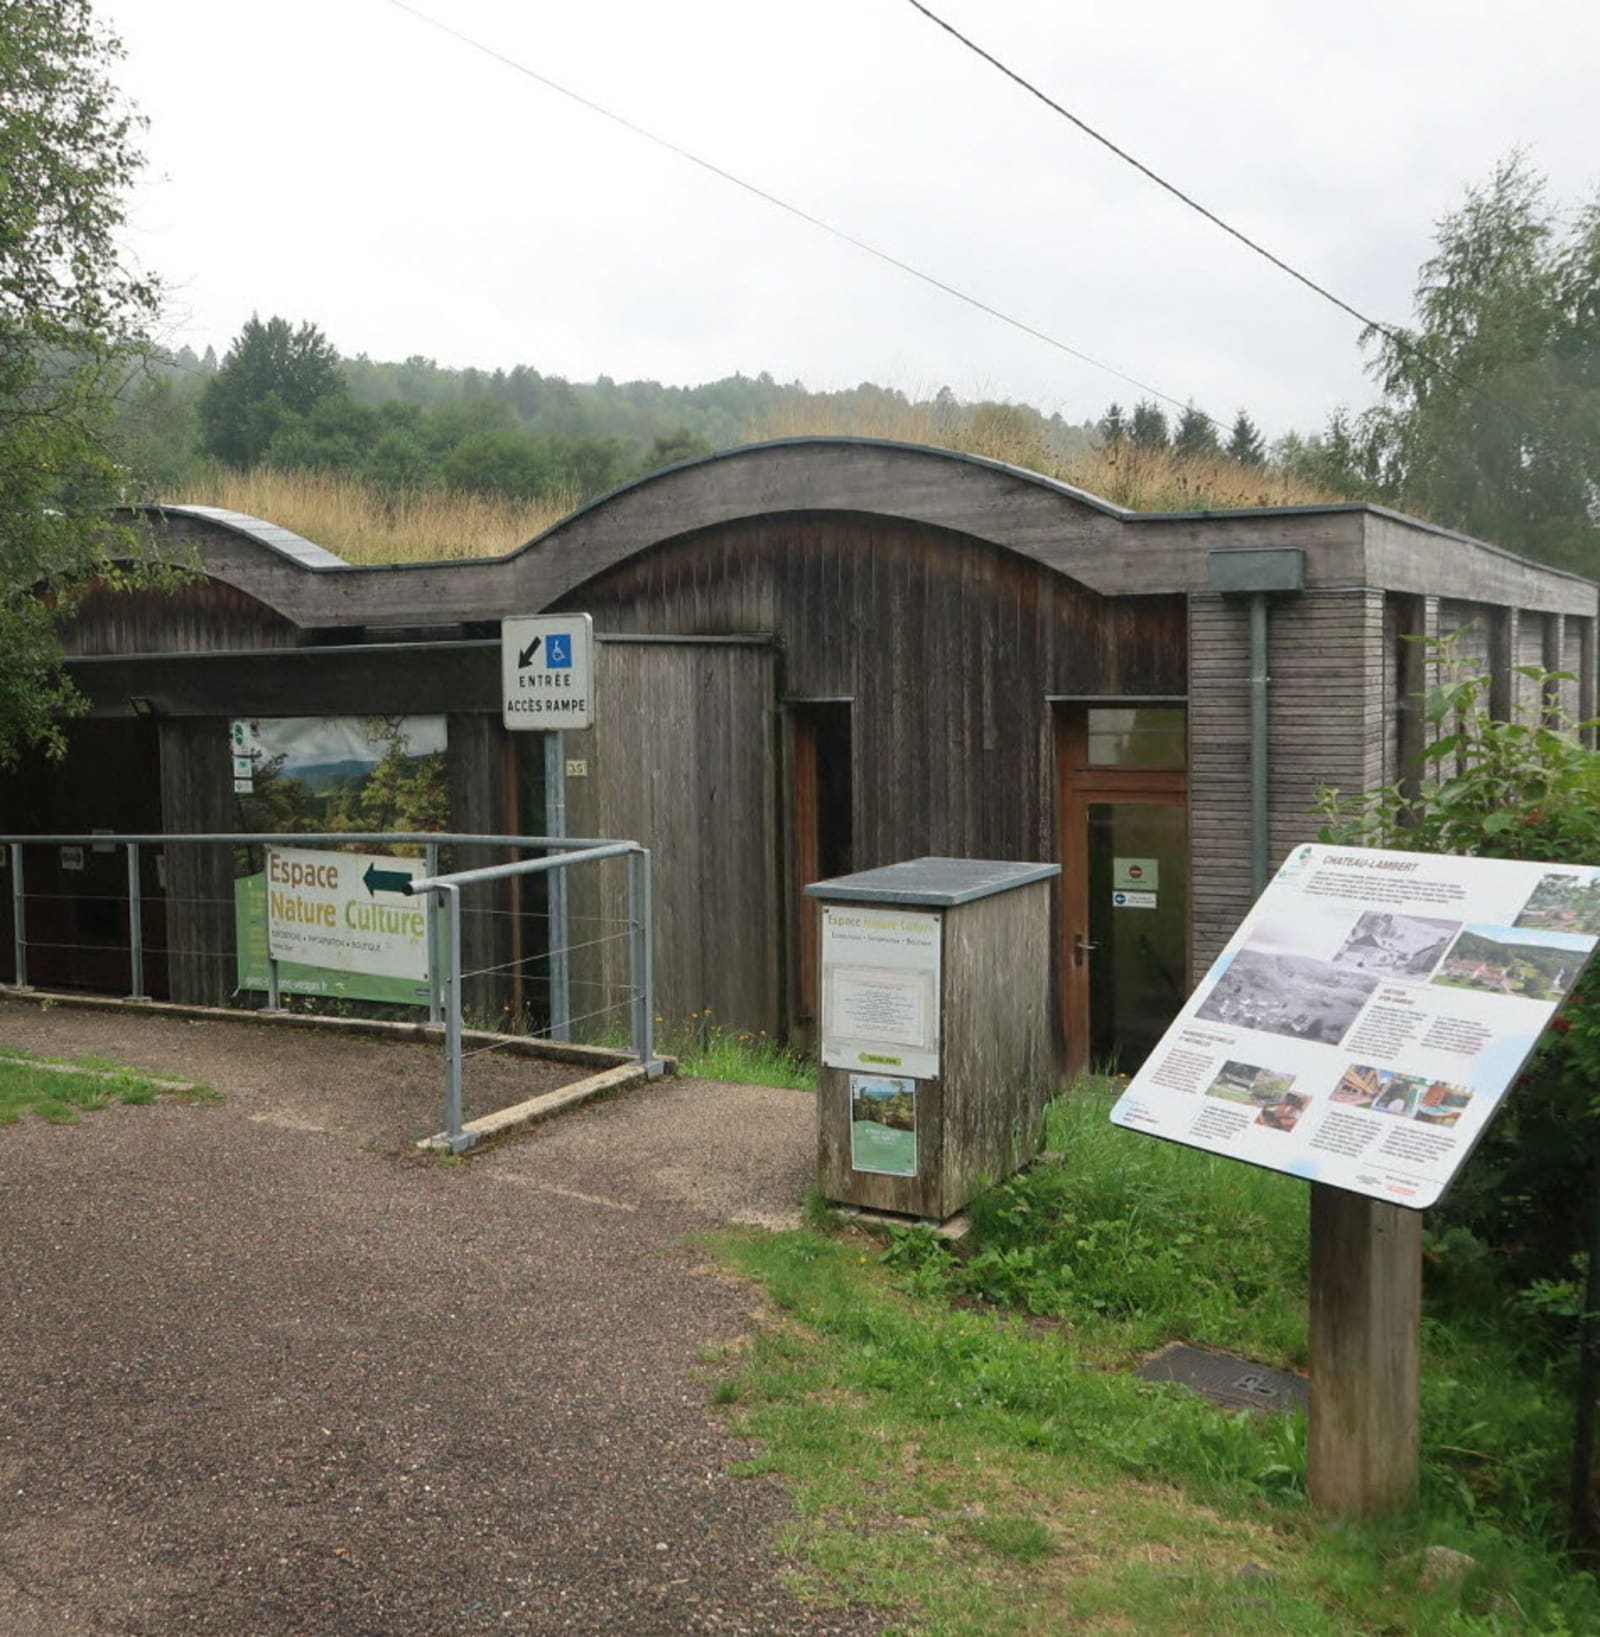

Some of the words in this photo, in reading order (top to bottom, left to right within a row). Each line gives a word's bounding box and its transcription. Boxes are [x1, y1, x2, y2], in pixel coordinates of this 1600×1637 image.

[519, 672, 571, 688] ENTRÉE
[507, 697, 543, 712] ACCÈS
[545, 699, 585, 714] RAMPE
[568, 763, 583, 775] 35
[270, 854, 338, 889] Espace
[271, 892, 336, 927] Nature
[345, 899, 425, 937] Culture
[828, 914, 862, 928] Espace
